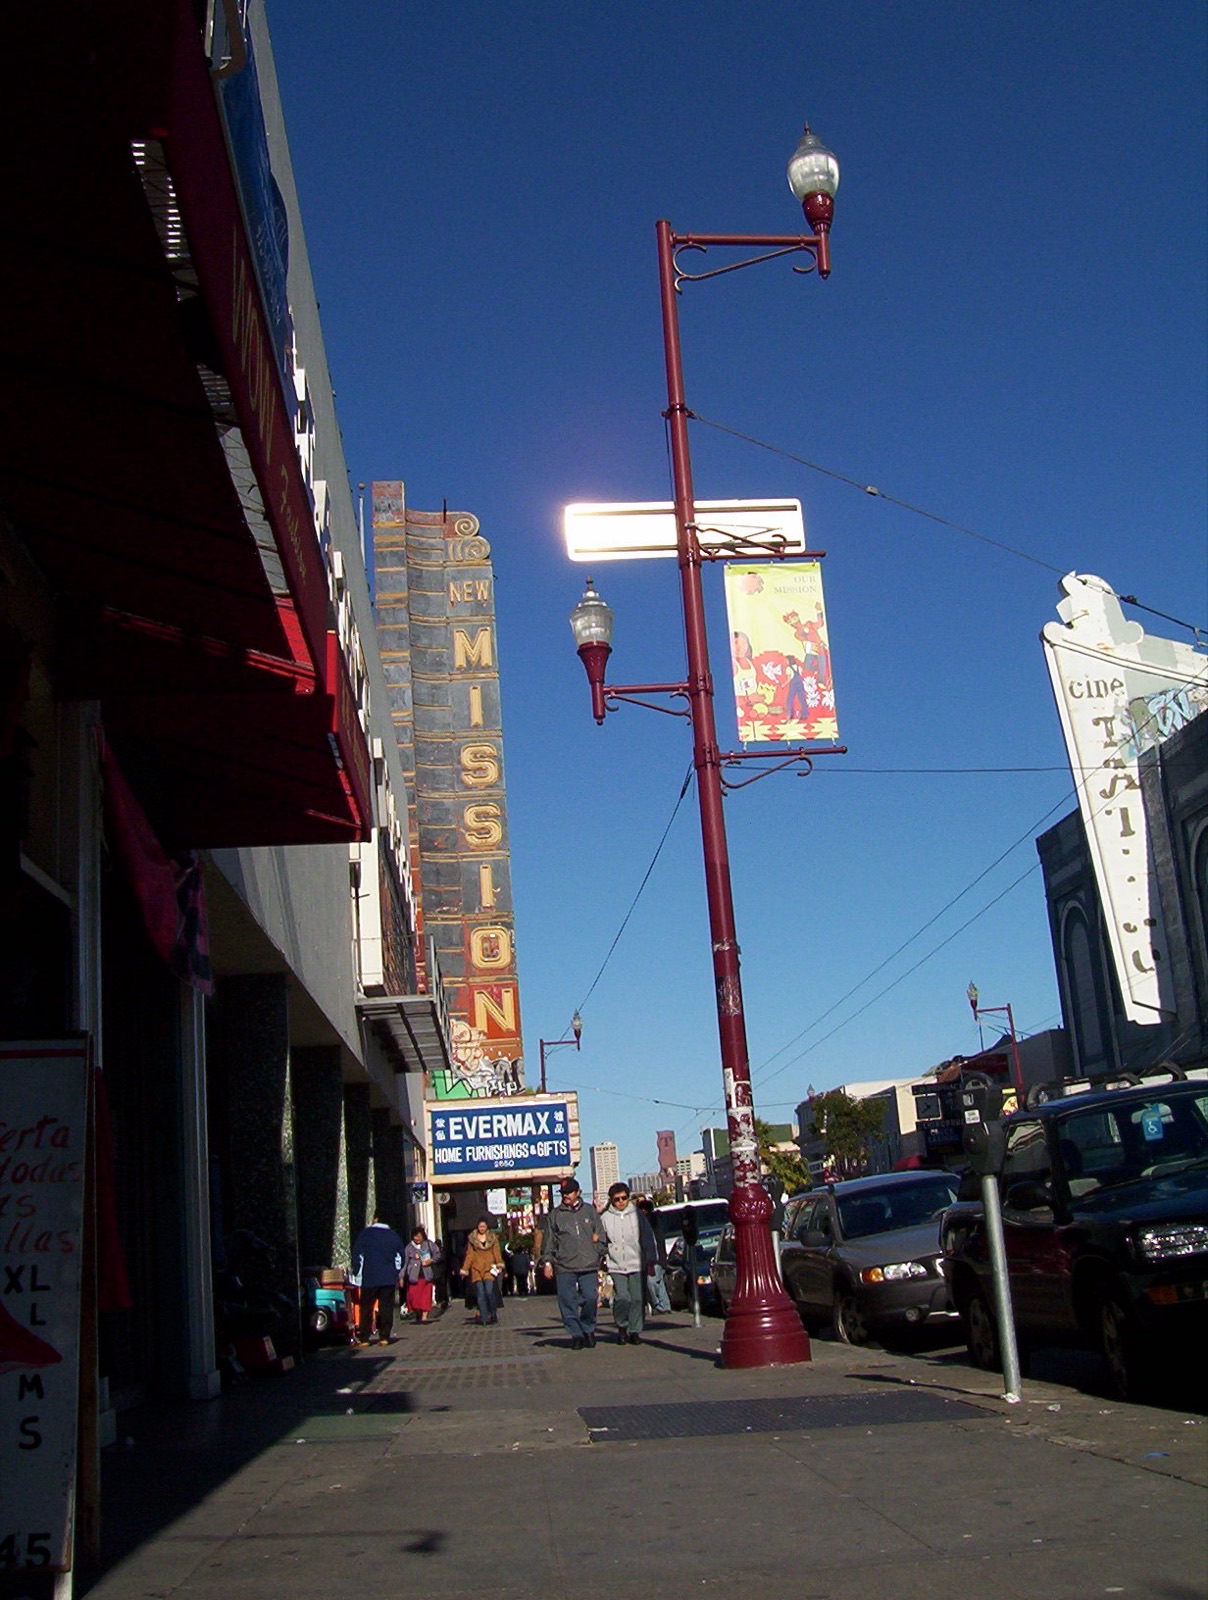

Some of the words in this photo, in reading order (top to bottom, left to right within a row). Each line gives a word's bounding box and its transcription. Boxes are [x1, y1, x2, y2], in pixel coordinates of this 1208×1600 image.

[449, 580, 490, 604] NEW
[774, 585, 817, 593] MISSION
[794, 575, 817, 583] OUR
[453, 627, 516, 1033] MISSION
[448, 1111, 551, 1141] EVERMAX
[434, 1146, 463, 1163] HOME
[466, 1142, 529, 1162] FURNISHINGS
[4, 1264, 51, 1294] XL
[30, 1302, 46, 1326] L
[18, 1373, 44, 1401] M
[18, 1416, 42, 1450] S
